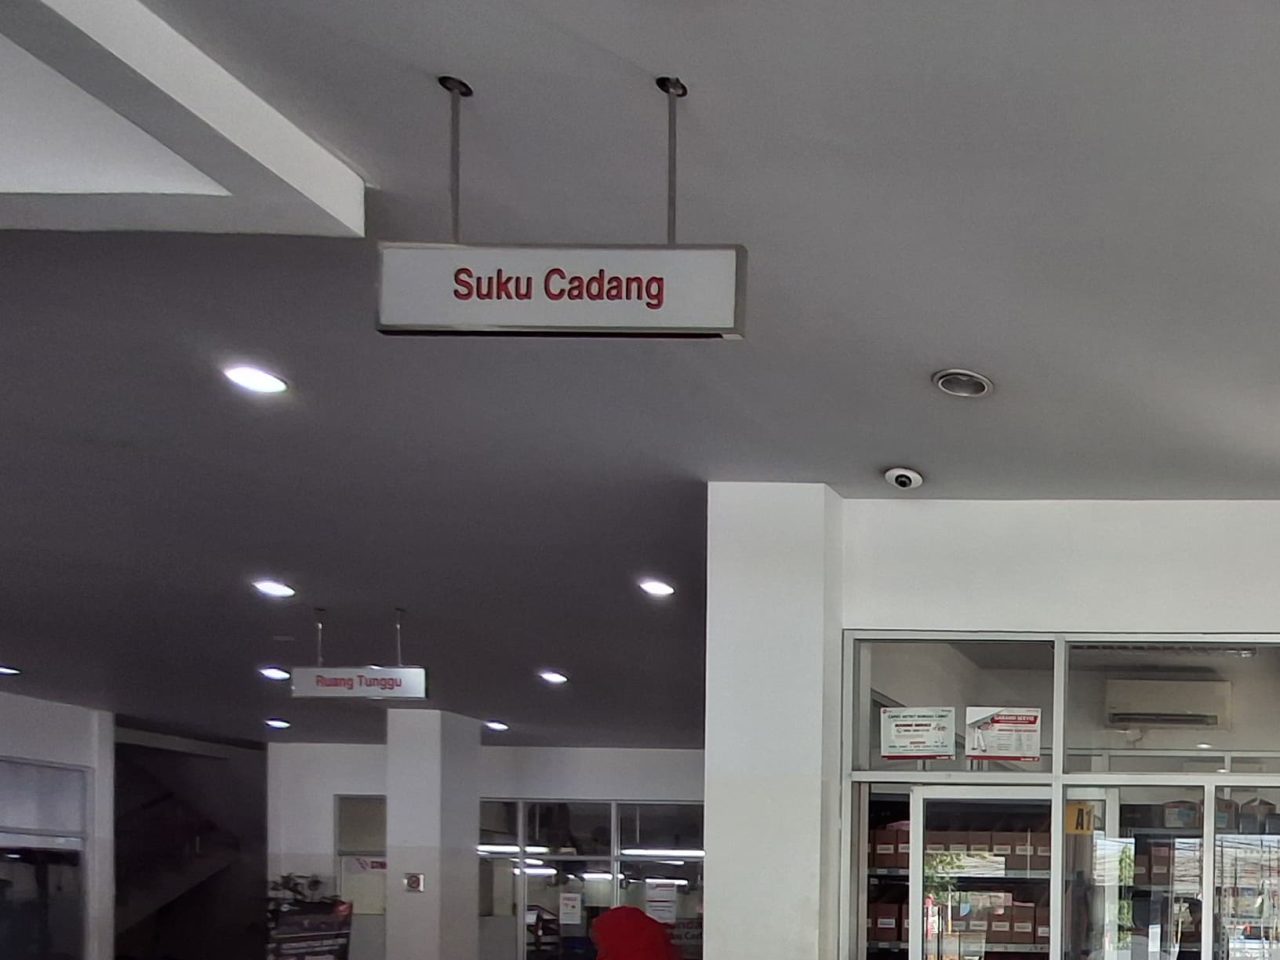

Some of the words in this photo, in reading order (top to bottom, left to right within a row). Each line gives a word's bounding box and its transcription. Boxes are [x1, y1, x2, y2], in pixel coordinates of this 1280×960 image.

[453, 267, 534, 301] Suku
[543, 267, 666, 310] Cadang
[315, 674, 354, 690] Ruang
[356, 674, 402, 690] Tunggu
